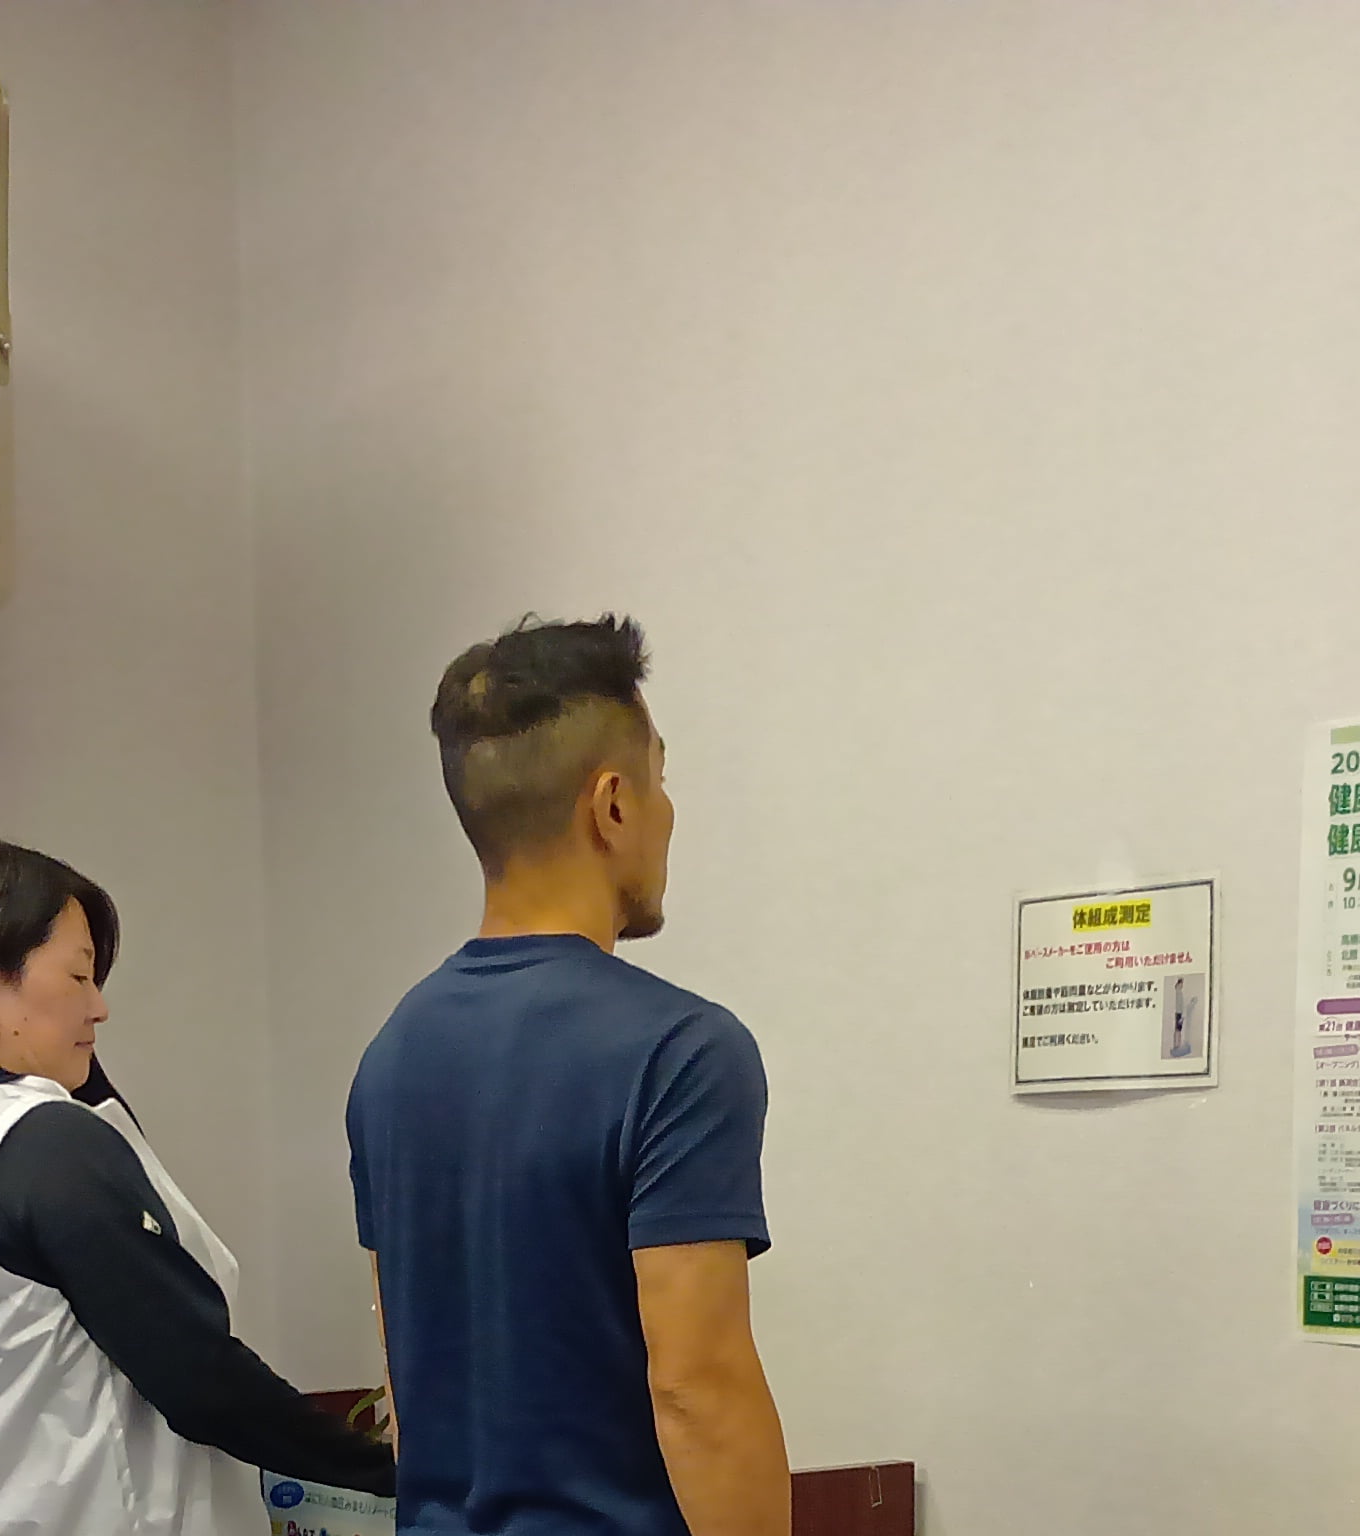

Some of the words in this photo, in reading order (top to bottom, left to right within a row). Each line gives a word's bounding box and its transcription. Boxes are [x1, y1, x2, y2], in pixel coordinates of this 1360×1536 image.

[1072, 903, 1151, 929] 体組成測定
